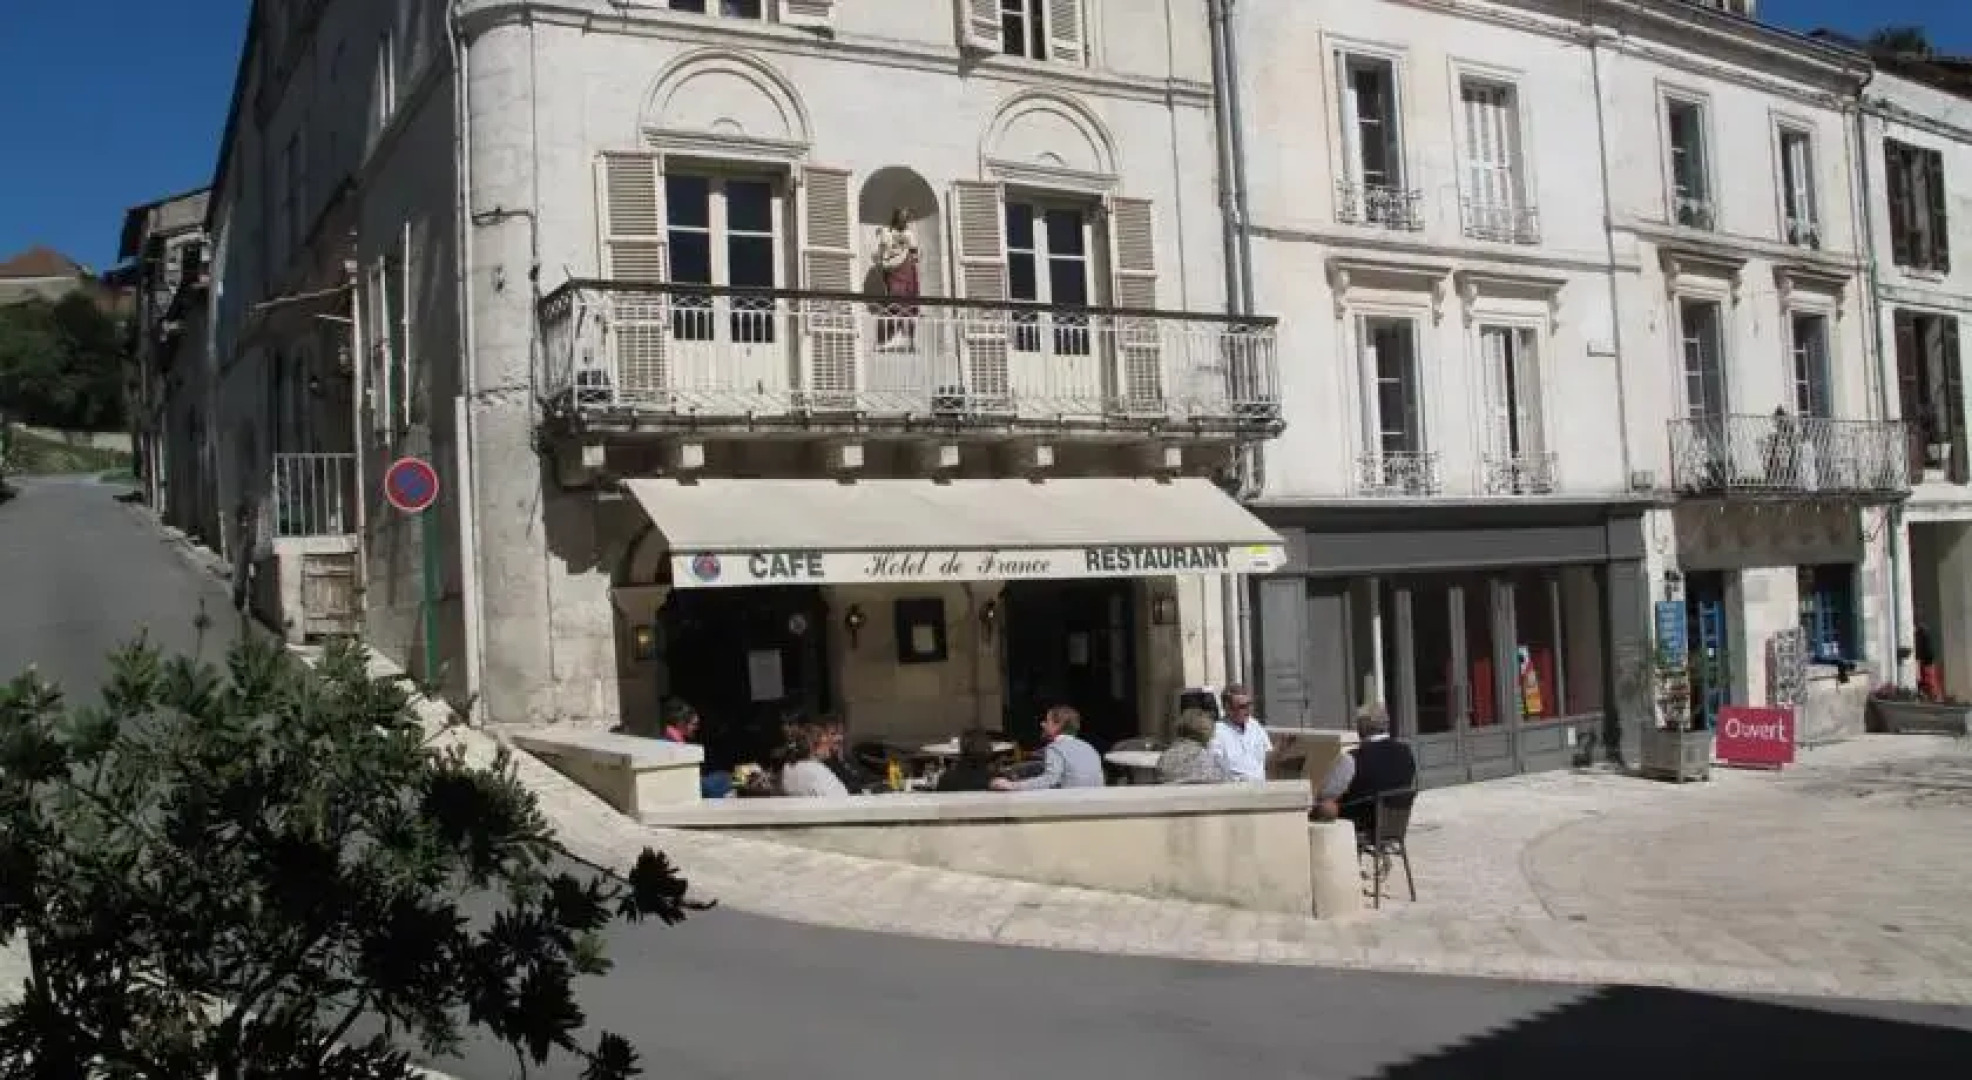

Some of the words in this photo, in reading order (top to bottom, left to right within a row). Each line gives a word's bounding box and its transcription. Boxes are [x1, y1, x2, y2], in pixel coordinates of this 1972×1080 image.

[938, 549, 964, 576] de
[976, 549, 1051, 575] France
[1085, 545, 1231, 572] RESTAURANT
[1724, 716, 1790, 743] Ouvert
